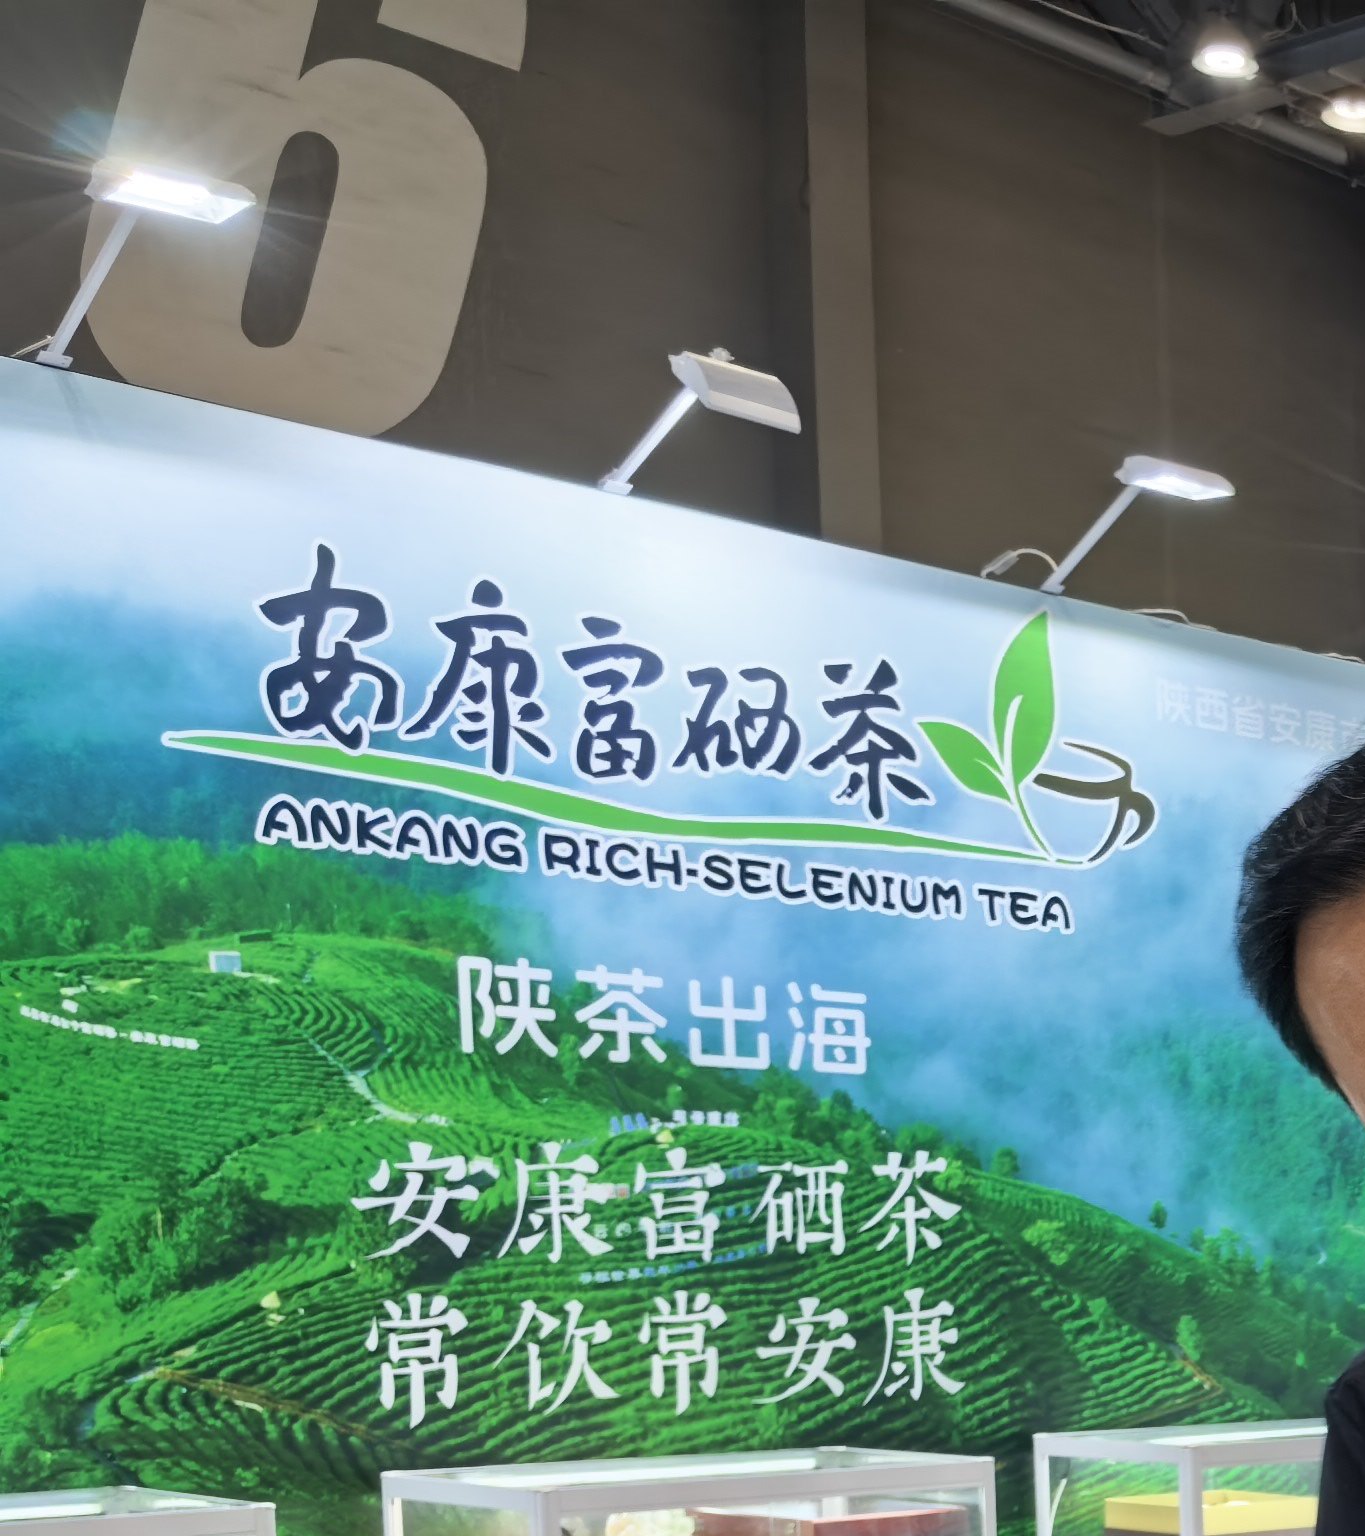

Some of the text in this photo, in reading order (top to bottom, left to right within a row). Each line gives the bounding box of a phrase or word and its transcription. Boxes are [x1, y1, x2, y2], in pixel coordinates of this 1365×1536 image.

[259, 543, 931, 820] 安康富硒茶
[262, 800, 1072, 932] ANKANG RICH-SELENIUM TEA
[455, 955, 872, 1075] 陕茶出海
[352, 1142, 962, 1266] 安康富硒茶
[364, 1287, 966, 1429] 常饮常安康
